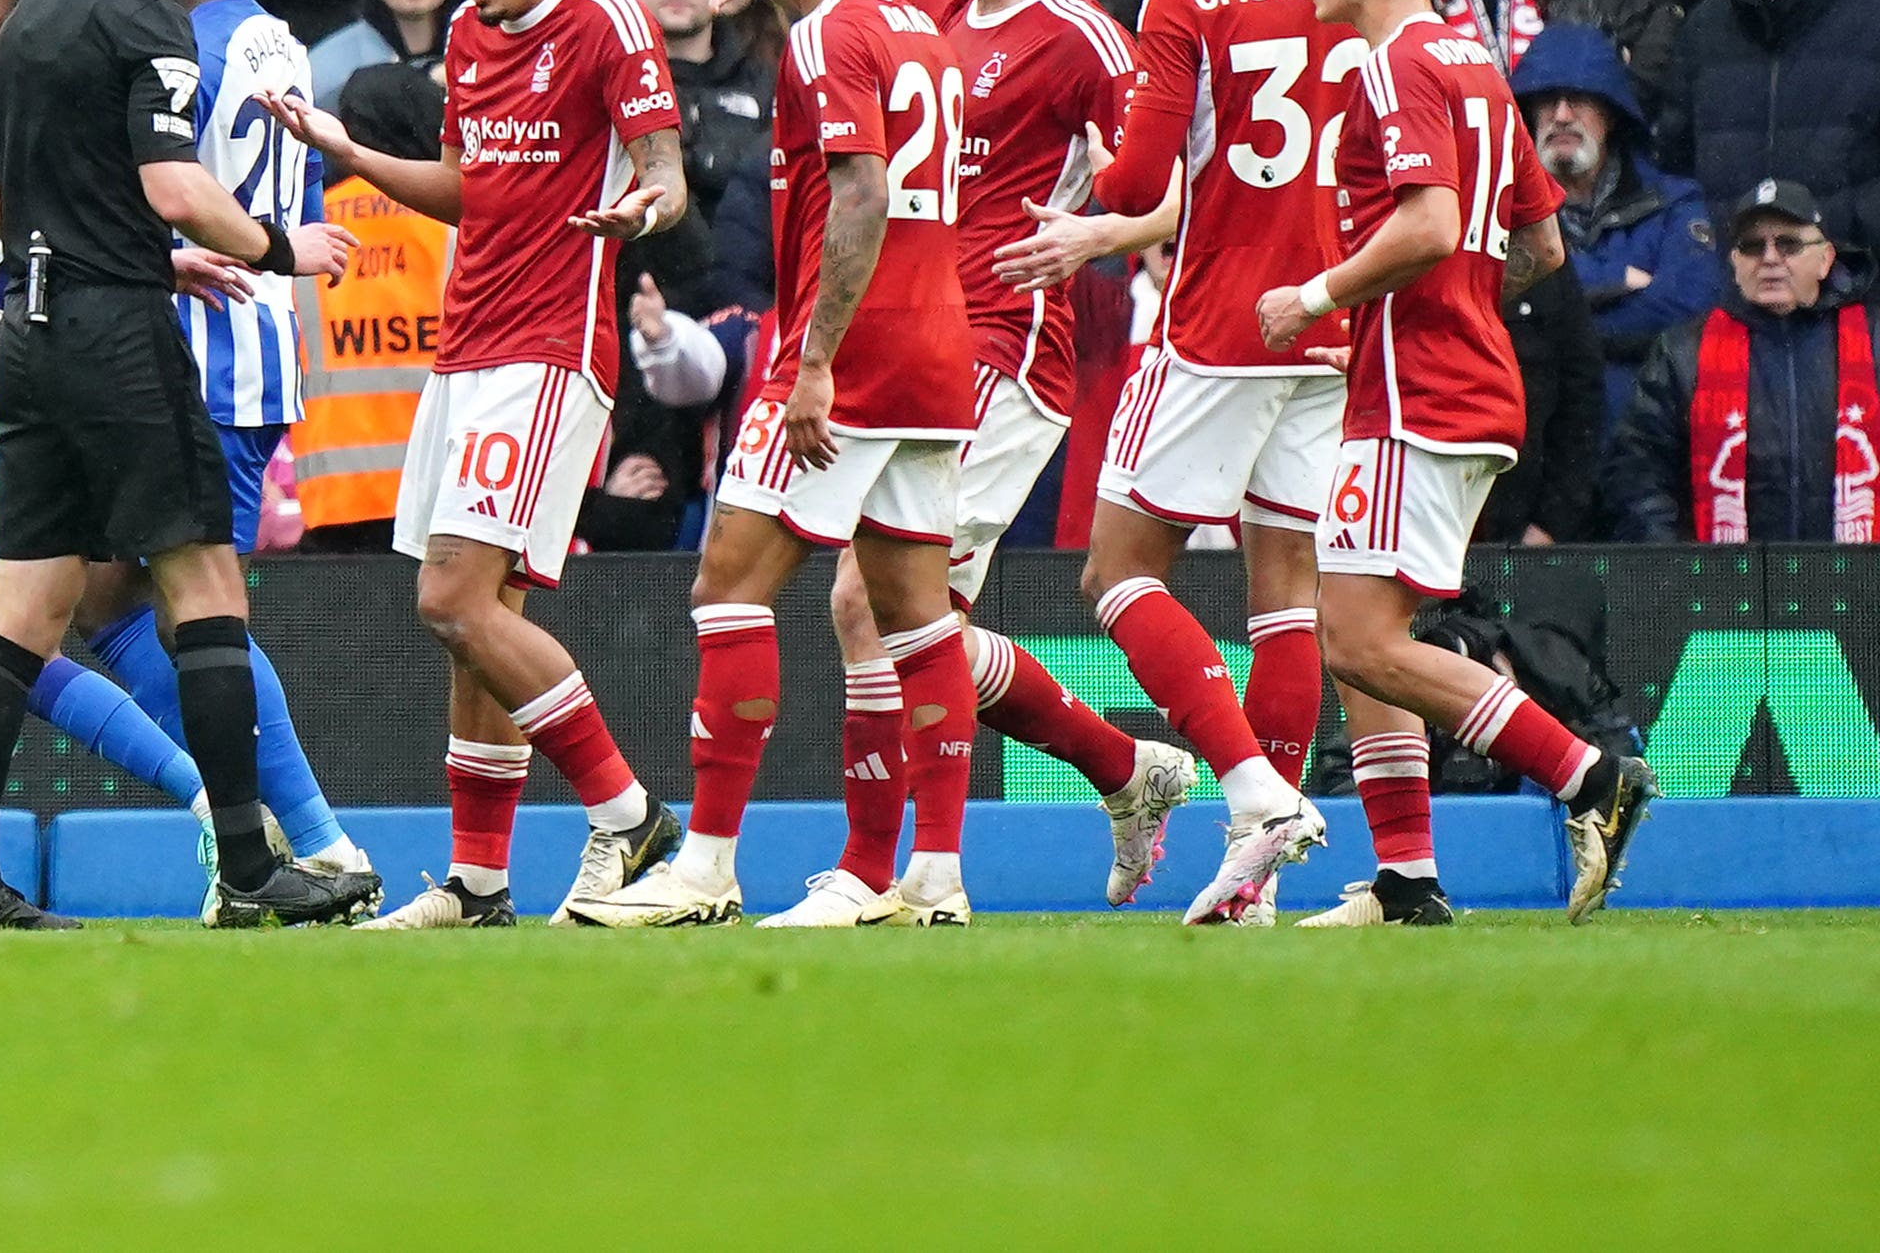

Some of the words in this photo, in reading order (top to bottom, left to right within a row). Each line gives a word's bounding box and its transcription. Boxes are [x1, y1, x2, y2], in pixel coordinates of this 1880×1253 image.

[886, 60, 965, 226] 28
[330, 315, 440, 356] WISE
[456, 431, 521, 491] 10
